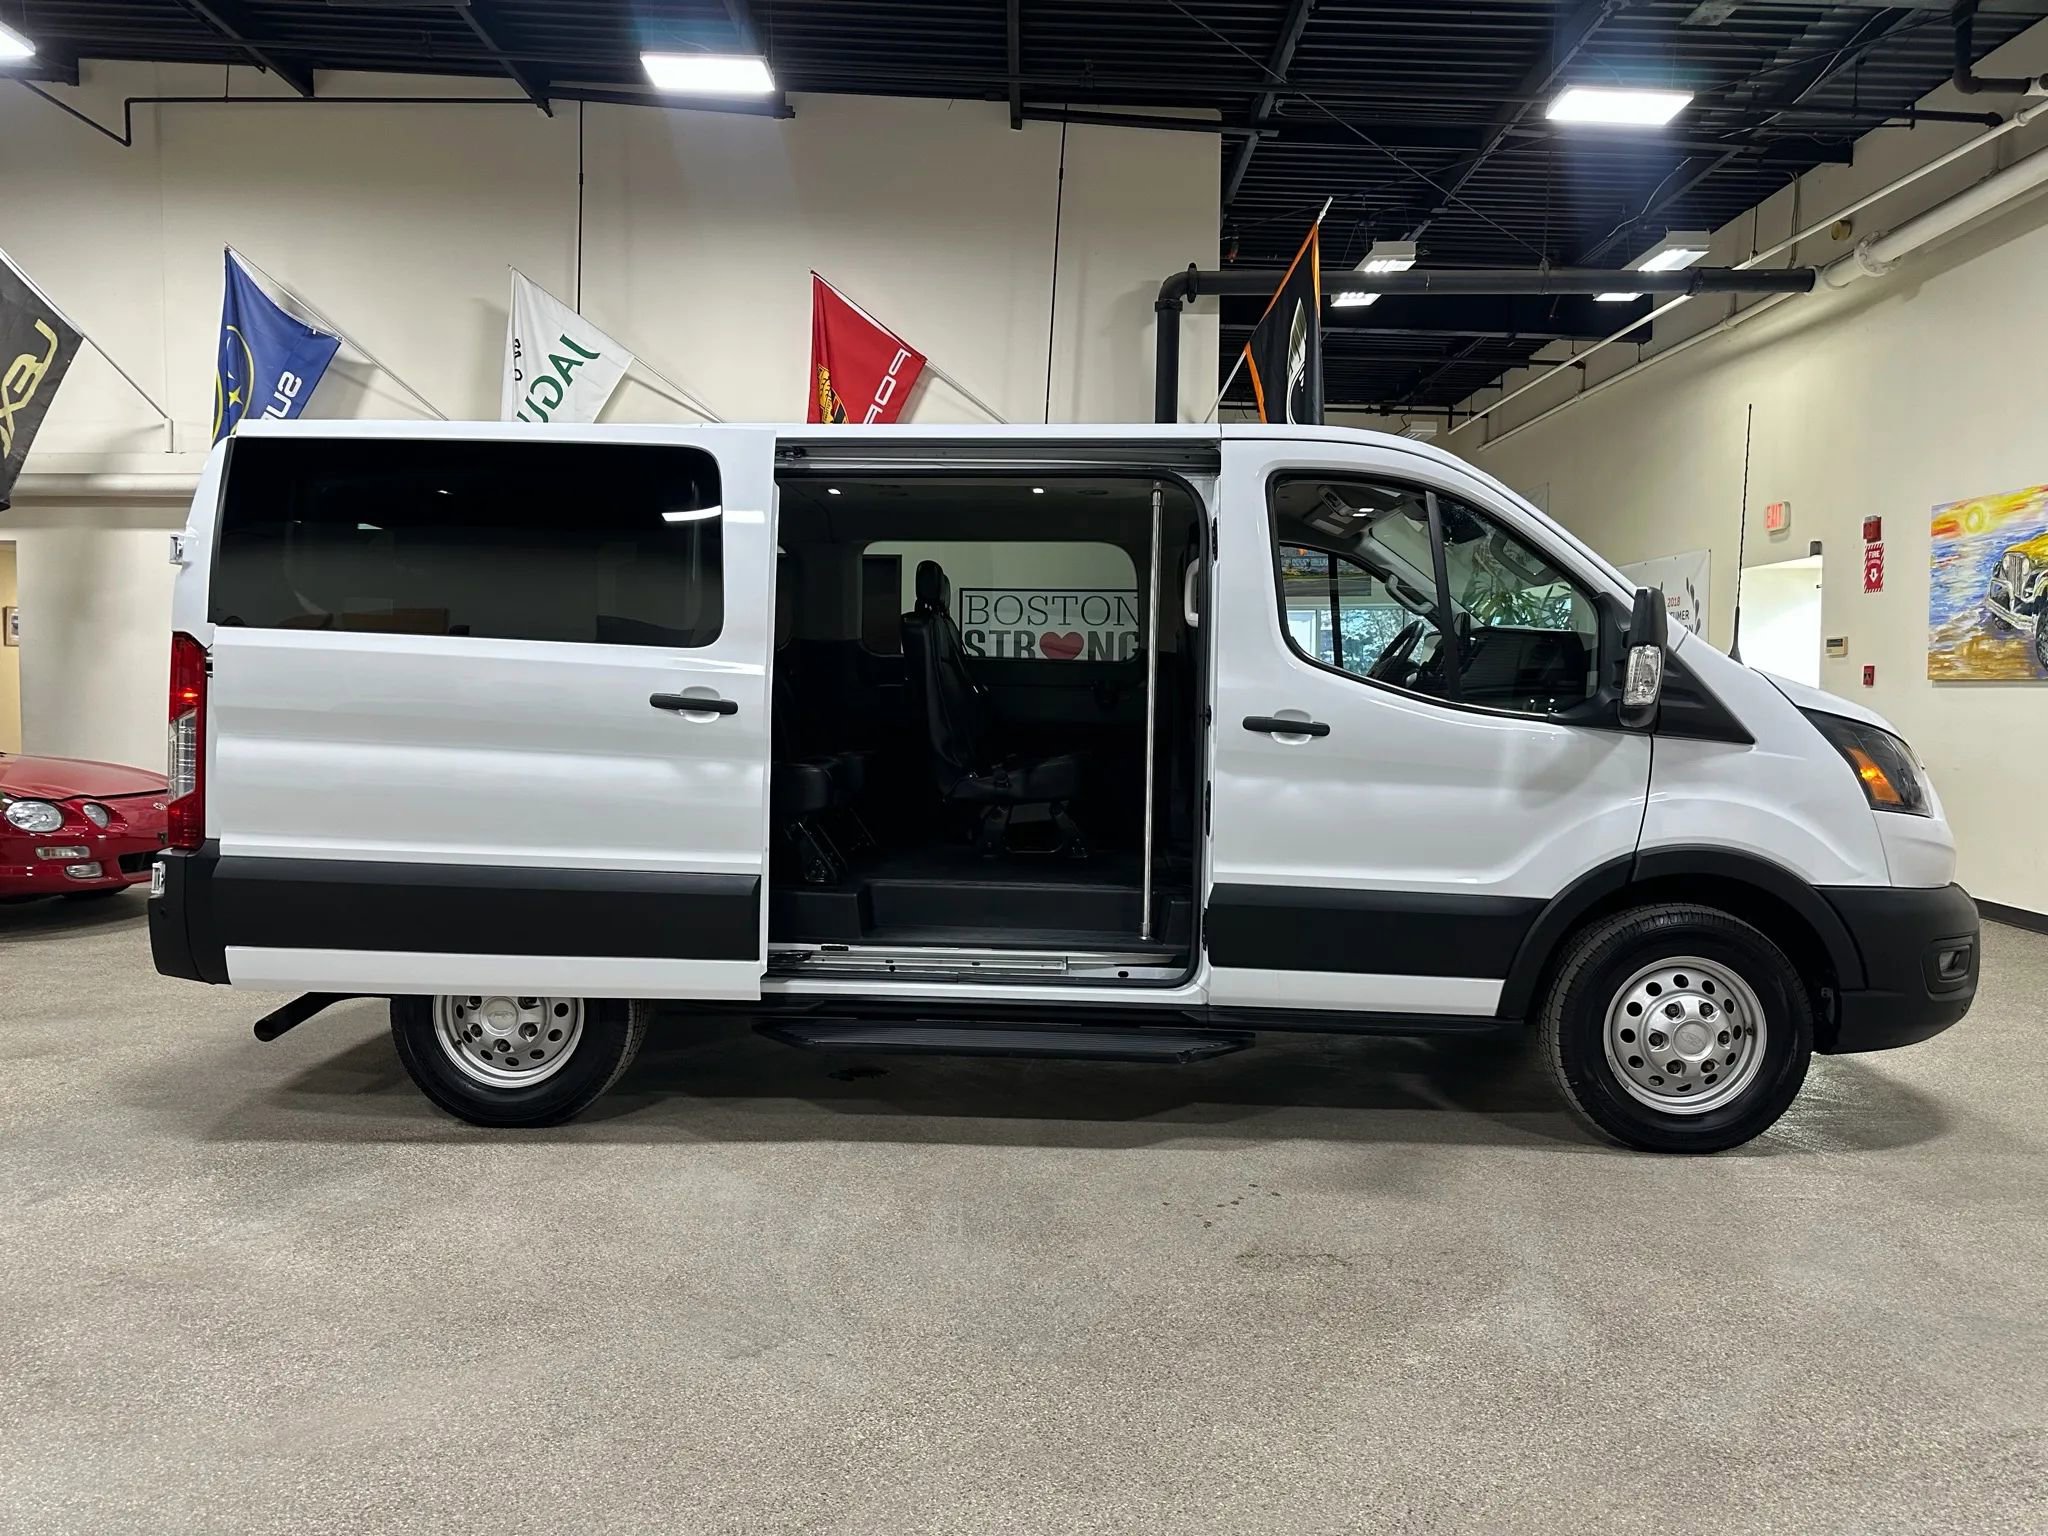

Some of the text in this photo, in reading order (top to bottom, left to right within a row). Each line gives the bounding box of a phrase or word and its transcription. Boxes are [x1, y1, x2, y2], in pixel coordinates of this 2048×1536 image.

[1766, 503, 1783, 529] EXIT
[1868, 550, 1881, 559] FIRE
[964, 595, 1139, 626] BOSTON
[1667, 596, 1681, 608] 2018
